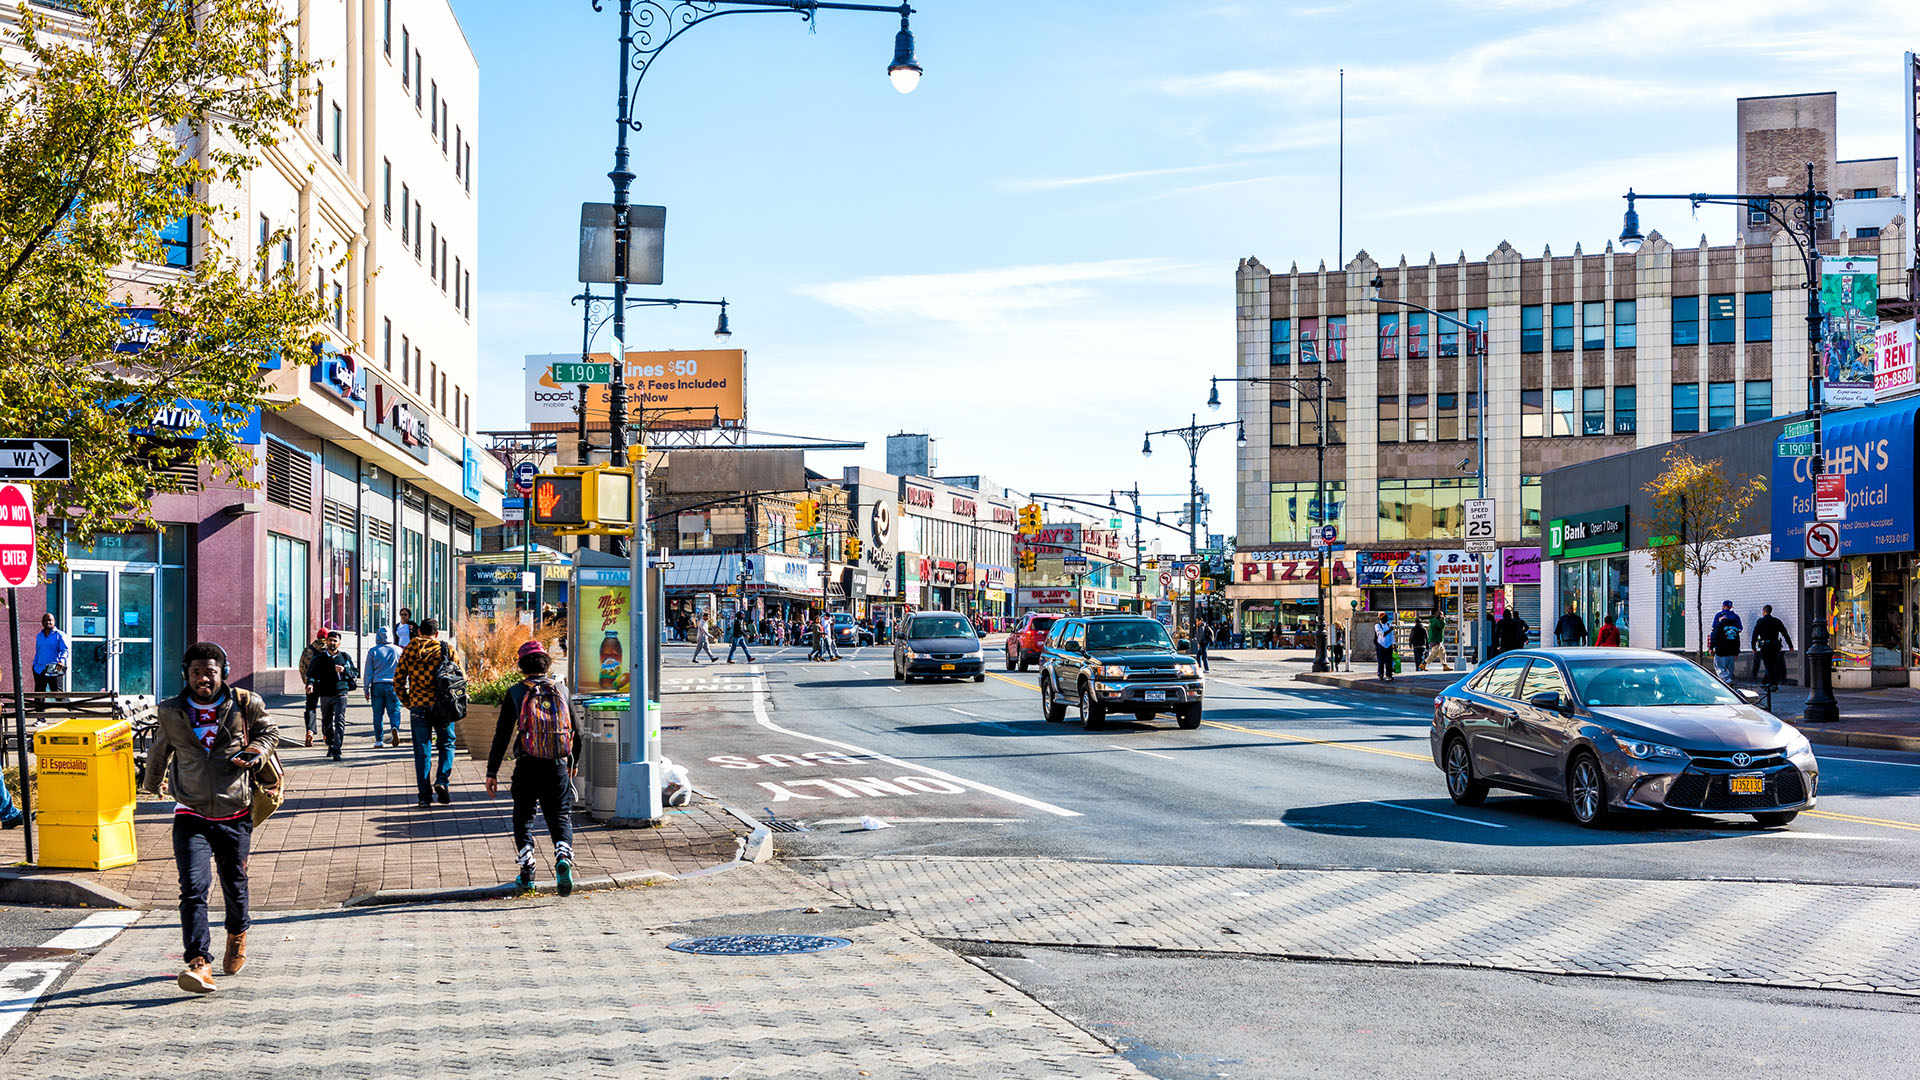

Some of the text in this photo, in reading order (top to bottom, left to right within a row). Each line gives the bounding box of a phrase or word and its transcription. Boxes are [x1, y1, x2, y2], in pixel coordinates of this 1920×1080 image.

[1884, 342, 1912, 369] RENT
[556, 365, 608, 381] E 190 St
[668, 360, 697, 376] $50
[648, 380, 675, 390] Fees
[678, 378, 727, 389] Included
[534, 390, 574, 402] boost
[643, 393, 668, 402] Now
[152, 405, 200, 427] ATM
[1789, 423, 1810, 437] Fordham
[1780, 444, 1786, 455] E
[1790, 444, 1804, 455] 190
[13, 452, 50, 467] WAY
[12, 505, 27, 521] NOT
[1031, 528, 1073, 544] JAY'S
[1469, 521, 1492, 536] 25
[1564, 520, 1619, 541] Bank Open 7 Days
[102, 537, 121, 547] 151
[1550, 527, 1562, 549] TD
[2, 550, 27, 566] ENTER
[1251, 550, 1283, 560] BEST
[1373, 552, 1410, 560] SHARP
[596, 571, 628, 581] TITAN
[1243, 561, 1350, 581] PIZZA
[1363, 565, 1419, 573] WIRELESS
[597, 592, 626, 609] Make
[1031, 589, 1071, 598] DR. JAY'S
[602, 606, 622, 618] time
[601, 617, 616, 631] for
[41, 758, 87, 771] El Especialito
[708, 751, 870, 769] BUS
[757, 776, 966, 802] ONLY
